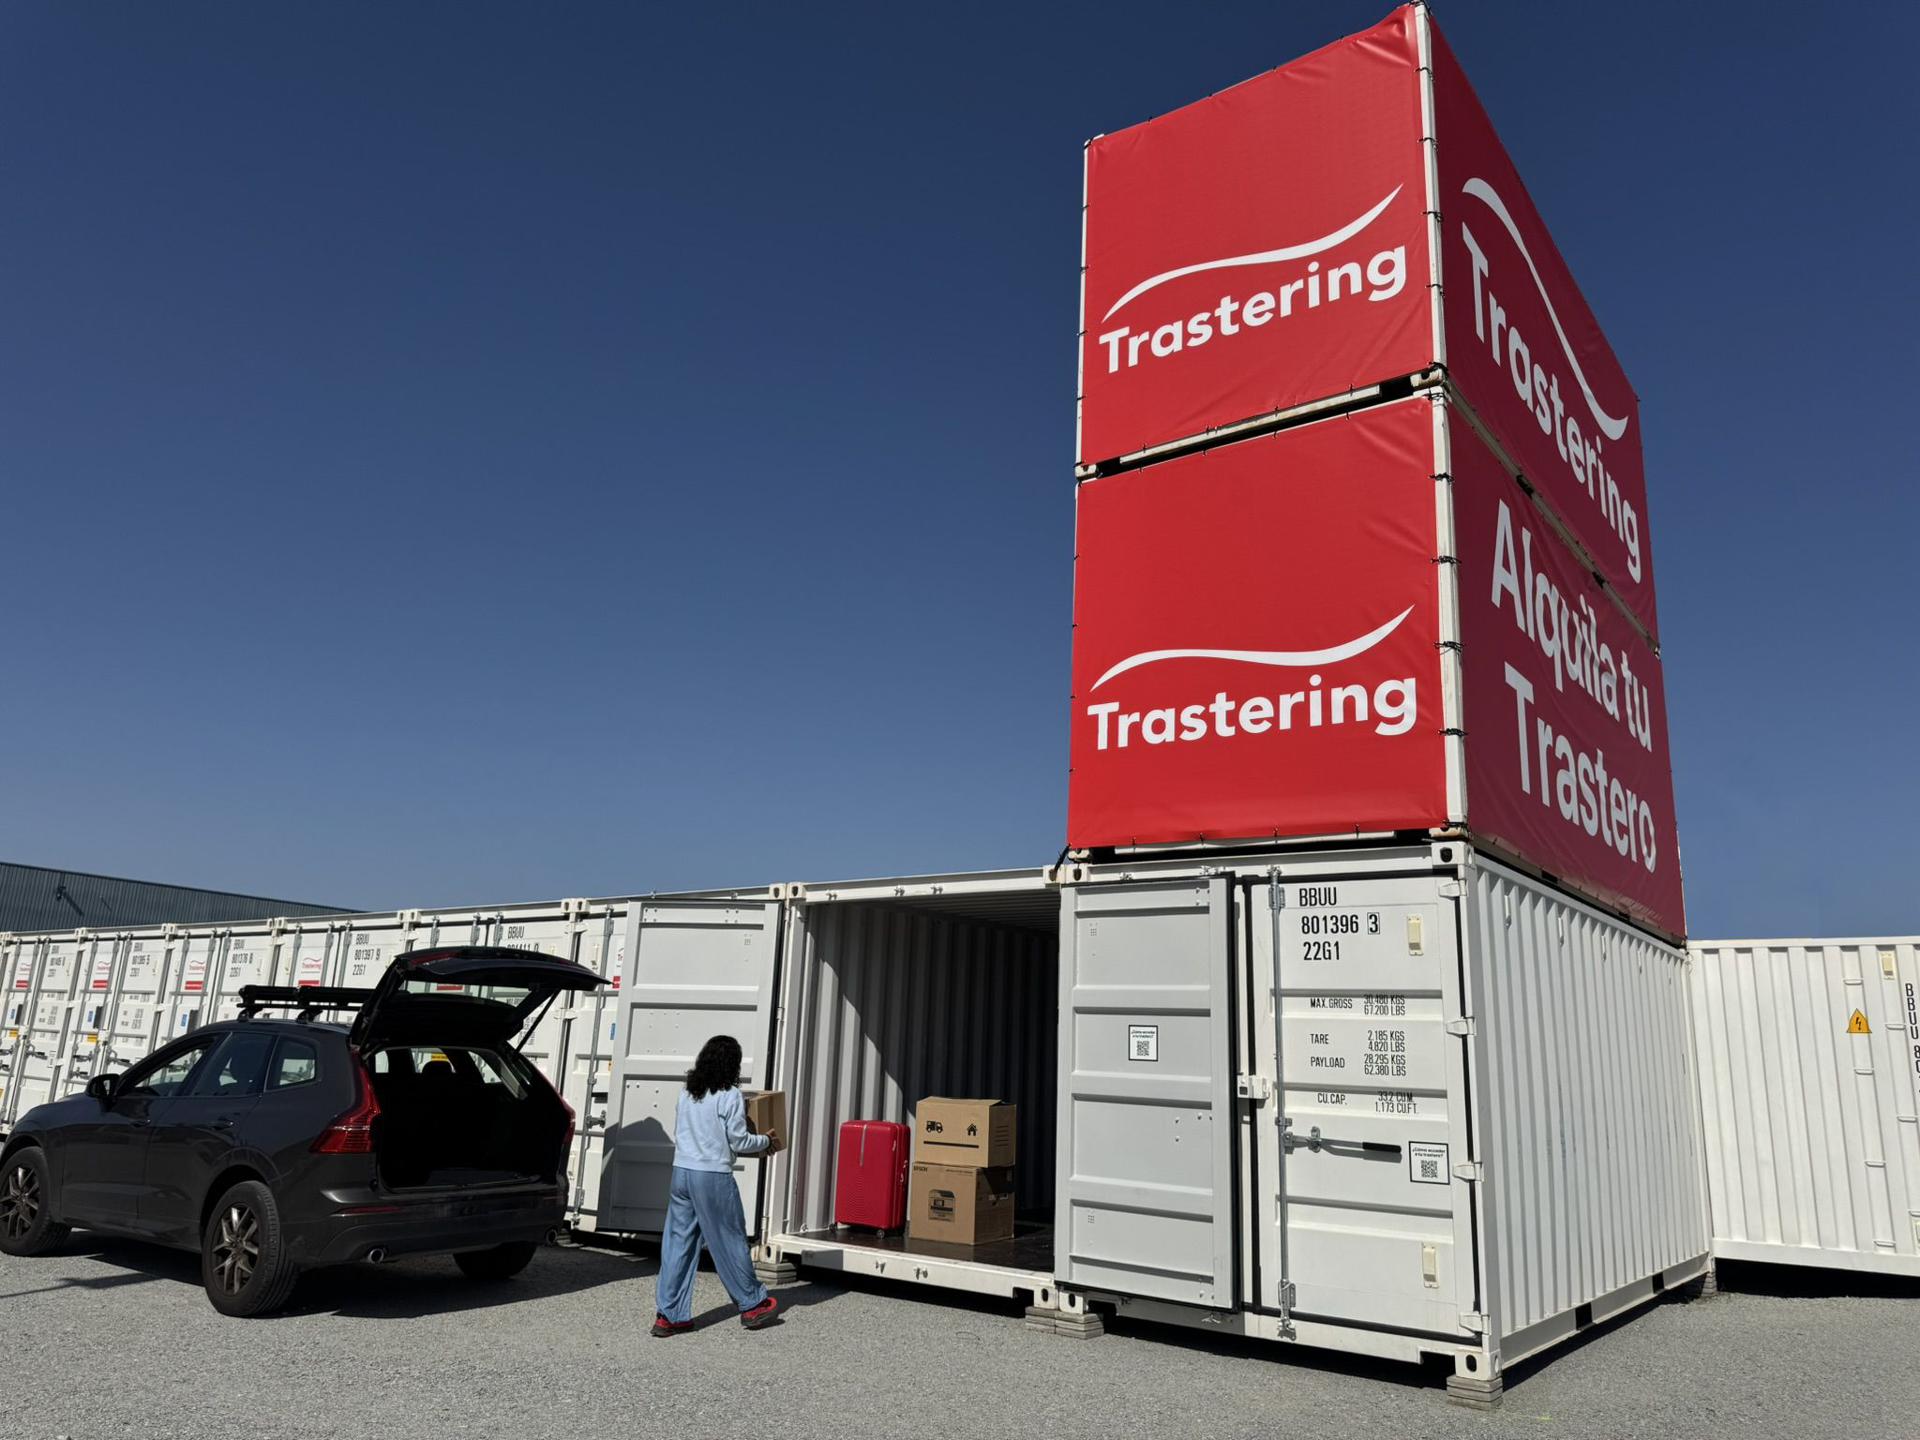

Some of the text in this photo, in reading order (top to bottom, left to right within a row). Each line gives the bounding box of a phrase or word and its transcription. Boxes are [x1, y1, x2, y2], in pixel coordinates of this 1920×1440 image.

[1098, 244, 1407, 373] Trastering
[1461, 221, 1642, 584] Trastering
[1490, 498, 1652, 753] Alquila tu
[1087, 673, 1417, 751] Trastering
[1503, 661, 1657, 874] Trastero
[1299, 886, 1337, 907] BBUU
[1301, 913, 1379, 935] 801396 3
[1303, 940, 1340, 961] 22G1
[1364, 994, 1406, 1005] 30.480 KGS
[1364, 1004, 1406, 1016] 67.200 LBS
[1905, 982, 1919, 1040] BBUU
[1310, 1033, 1329, 1045] TARE
[1367, 1030, 1405, 1042] 2.185 KGS
[1368, 1041, 1406, 1053] 4.820 LBS
[1310, 1056, 1346, 1068] PAYLOAD
[1364, 1053, 1406, 1066] 28.295 KGS
[1364, 1064, 1407, 1077] 62.380 LBS
[1375, 1102, 1395, 1113] 1.173
